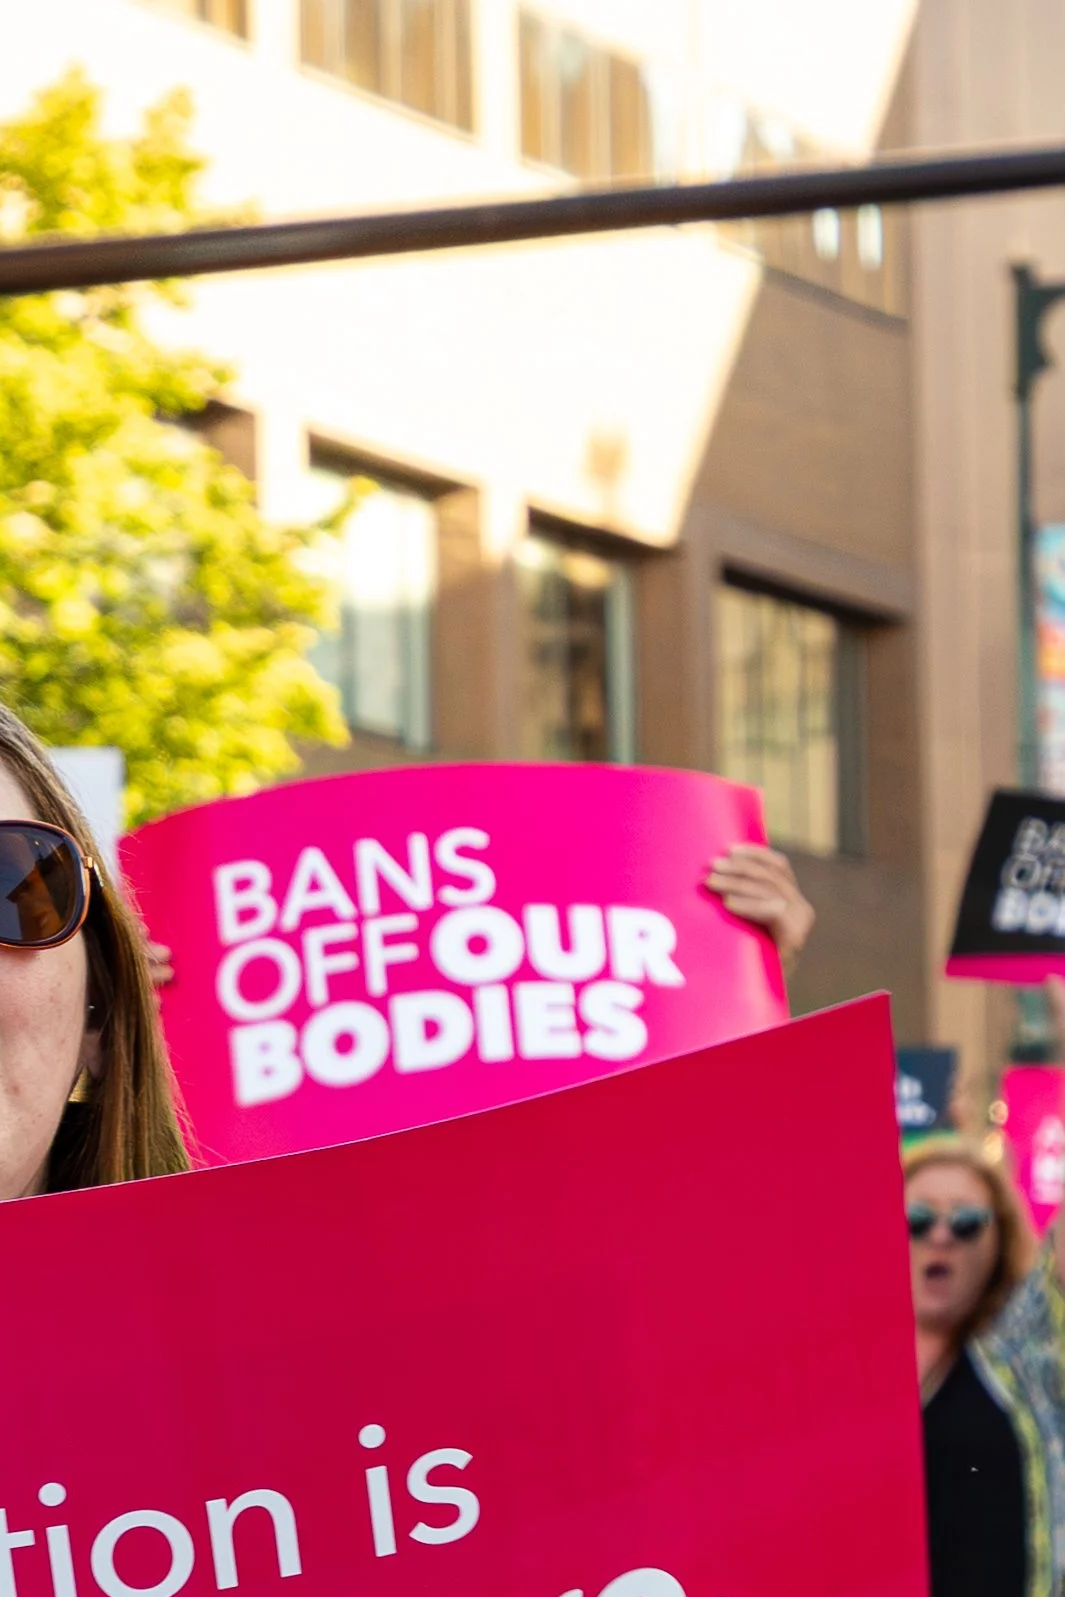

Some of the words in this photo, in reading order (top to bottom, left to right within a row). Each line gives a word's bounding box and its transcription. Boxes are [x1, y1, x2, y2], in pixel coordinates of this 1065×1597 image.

[213, 826, 497, 945] BANS
[216, 914, 419, 1022] OFF
[429, 903, 687, 987] OUR
[229, 981, 648, 1108] BODIES
[358, 1423, 480, 1557] is
